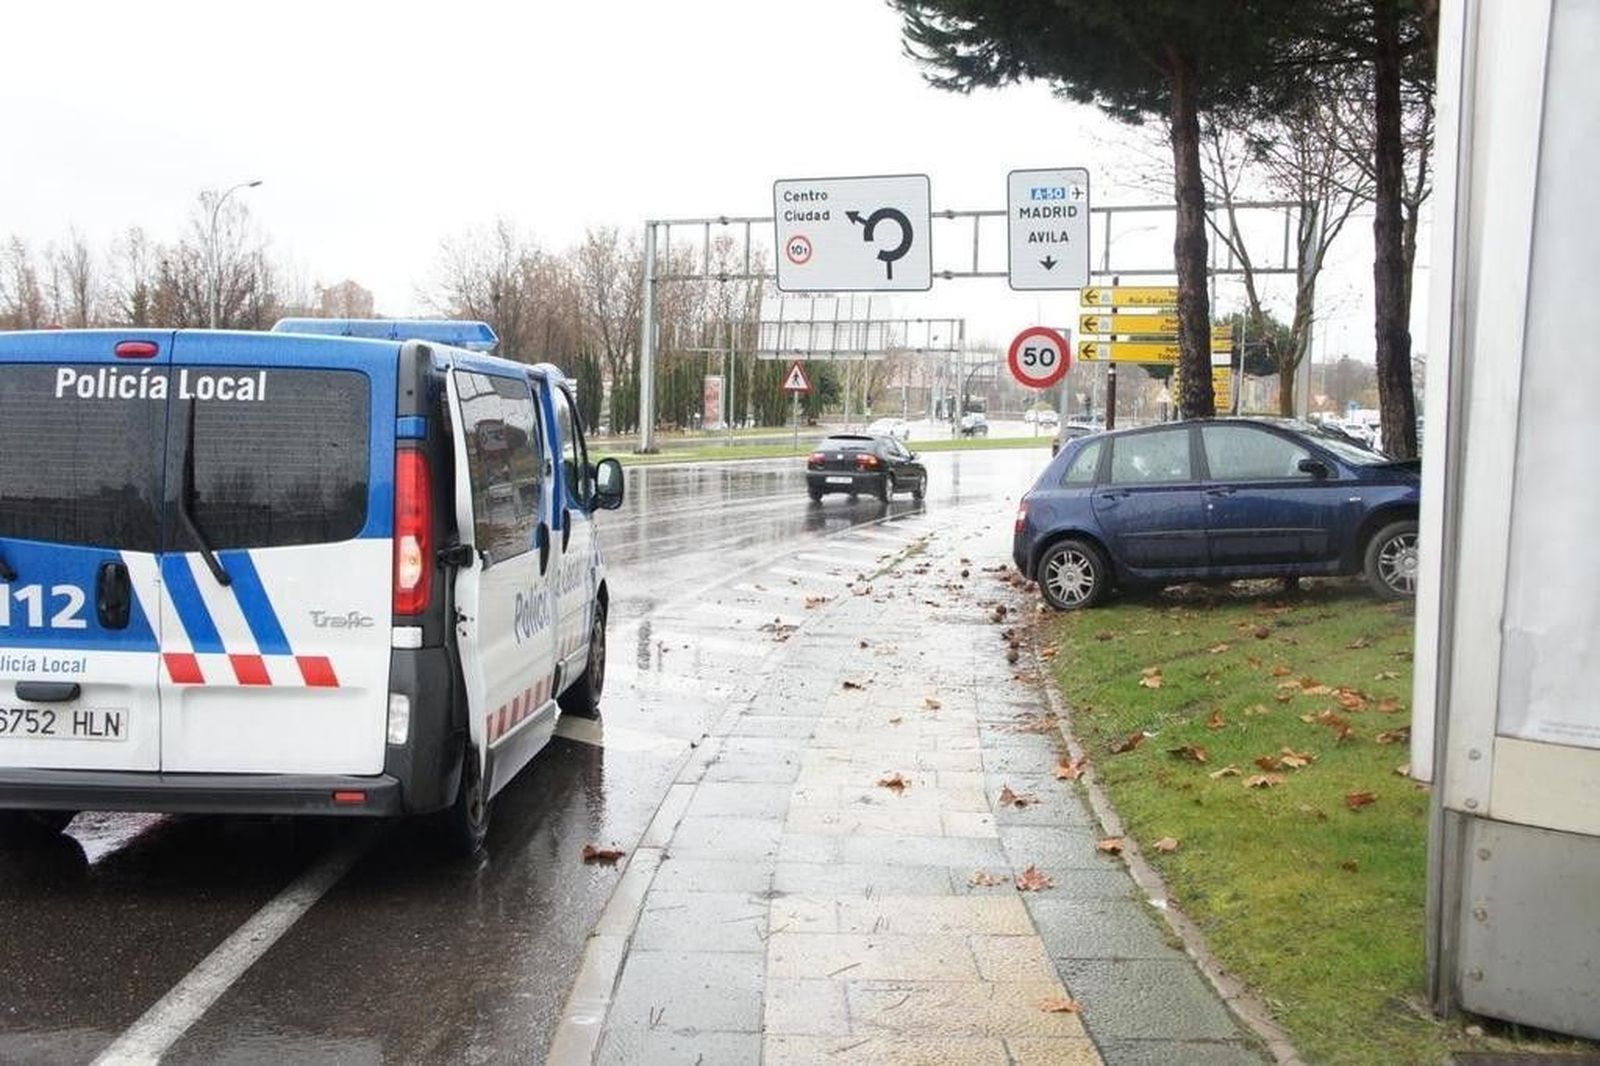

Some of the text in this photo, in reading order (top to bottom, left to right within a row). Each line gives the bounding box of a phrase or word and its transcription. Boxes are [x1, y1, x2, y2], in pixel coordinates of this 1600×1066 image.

[783, 189, 828, 202] Centro
[784, 209, 830, 222] Ciudad
[1019, 205, 1078, 219] MADRID
[1028, 230, 1069, 243] AVILA
[1023, 347, 1055, 367] 50
[55, 366, 267, 401] Policía Local
[308, 610, 375, 630] Trafic
[0, 654, 87, 673] licía Local
[72, 710, 121, 737] HLN
